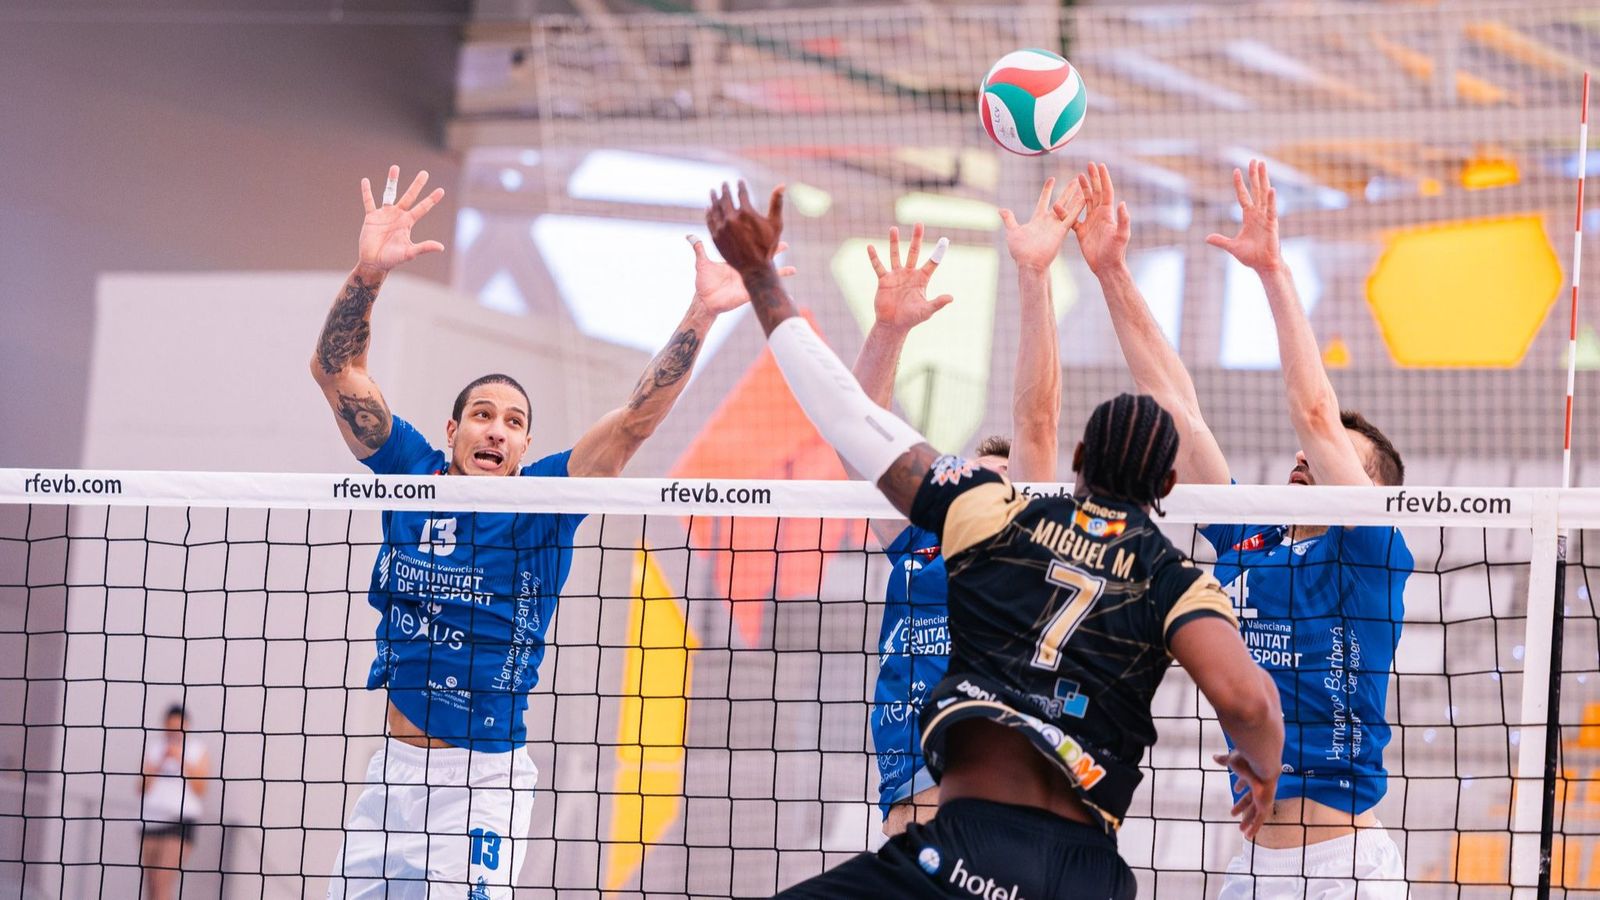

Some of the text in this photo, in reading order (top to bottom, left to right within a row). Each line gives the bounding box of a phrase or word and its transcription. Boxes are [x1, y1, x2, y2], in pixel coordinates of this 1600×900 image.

[24, 473, 122, 495] rfevb.com
[332, 477, 436, 499] rfevb.com
[660, 481, 772, 505] rfevb.com
[1386, 490, 1512, 515] rfevb.com
[417, 517, 457, 557] 13
[1030, 518, 1136, 582] MIGUEL M.
[395, 561, 484, 590] COMUNITAT
[397, 577, 415, 595] DE
[1030, 559, 1106, 672] 7
[1247, 620, 1291, 633] Valenciana
[1324, 626, 1344, 692] Barberá
[470, 828, 501, 871] 13
[949, 858, 1024, 900] hotel
